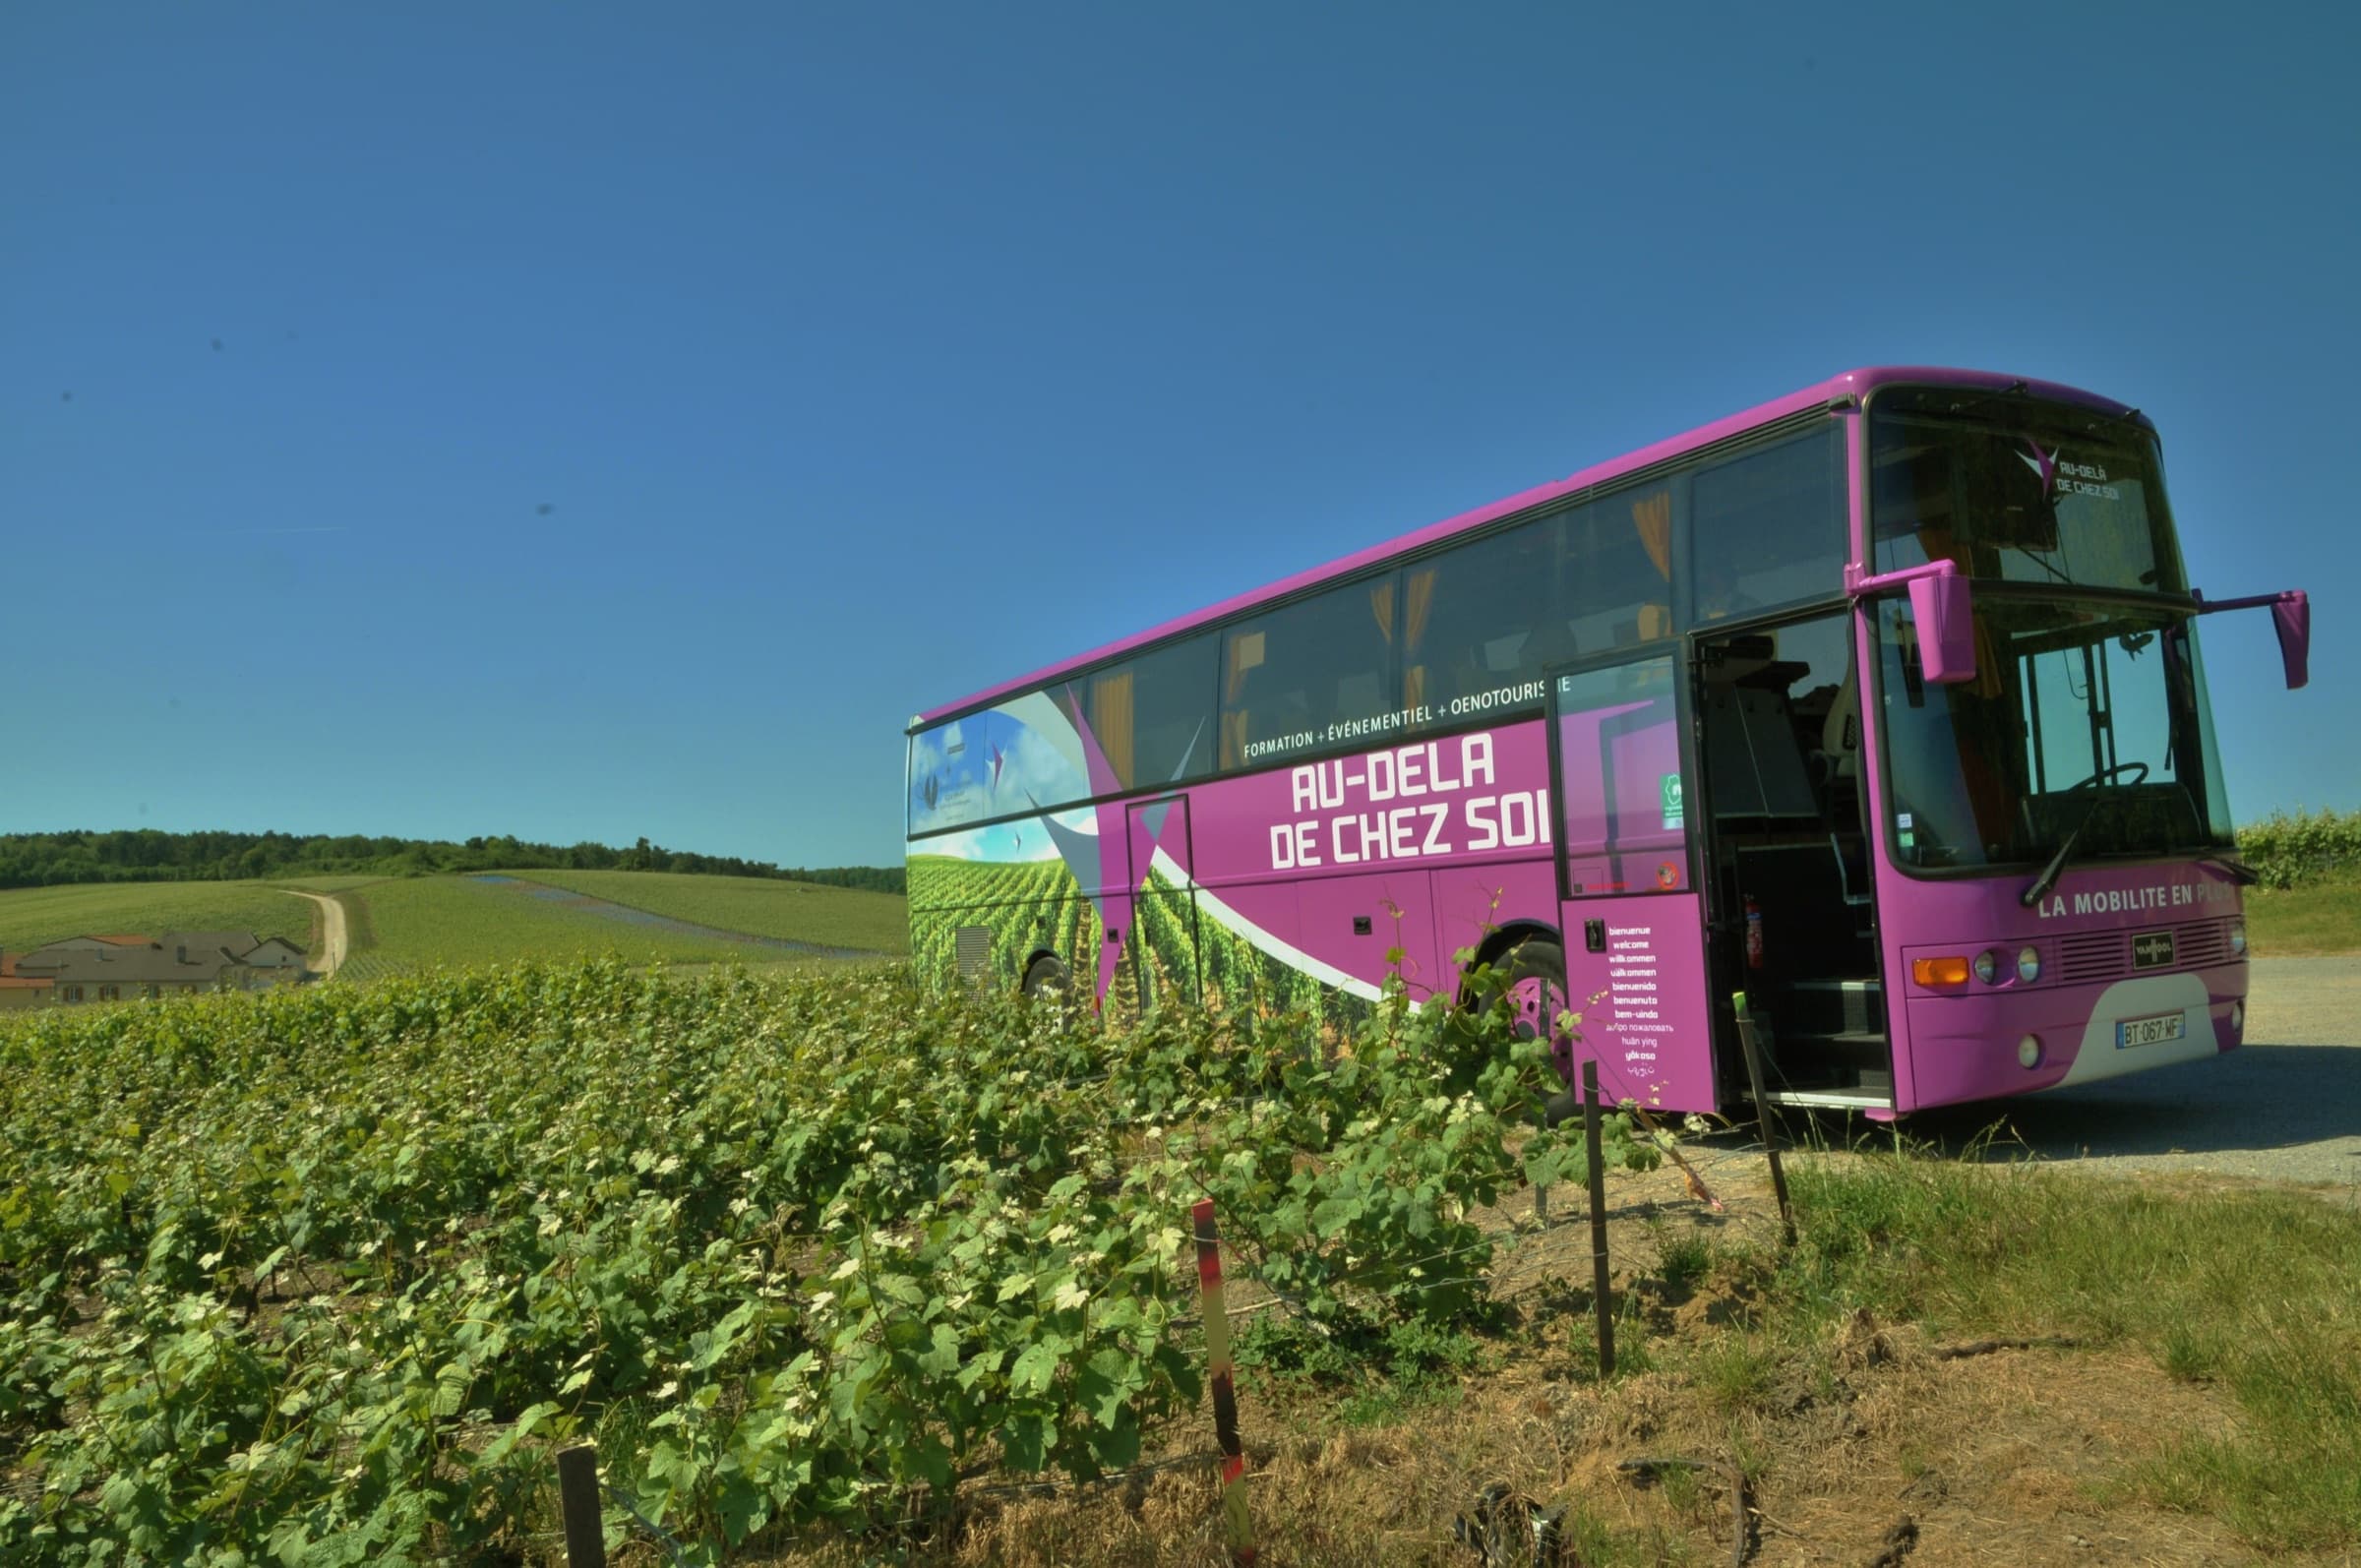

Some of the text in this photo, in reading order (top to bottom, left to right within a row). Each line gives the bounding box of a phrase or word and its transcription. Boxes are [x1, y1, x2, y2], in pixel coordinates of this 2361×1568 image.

[2056, 478, 2119, 501] DE CHEZ SOI
[1244, 731, 1313, 758] FORMATION
[1328, 705, 1432, 741] ÉVÉNEMENTIEL
[1451, 676, 1571, 715] OENOTOURISE
[1270, 789, 1551, 870] DE CHEZ SOI
[2038, 895, 2067, 918] LA
[2075, 886, 2167, 915] MOBILITE
[2172, 884, 2193, 905] EN
[1613, 939, 1649, 949] welcome
[1608, 954, 1657, 964] willkommen
